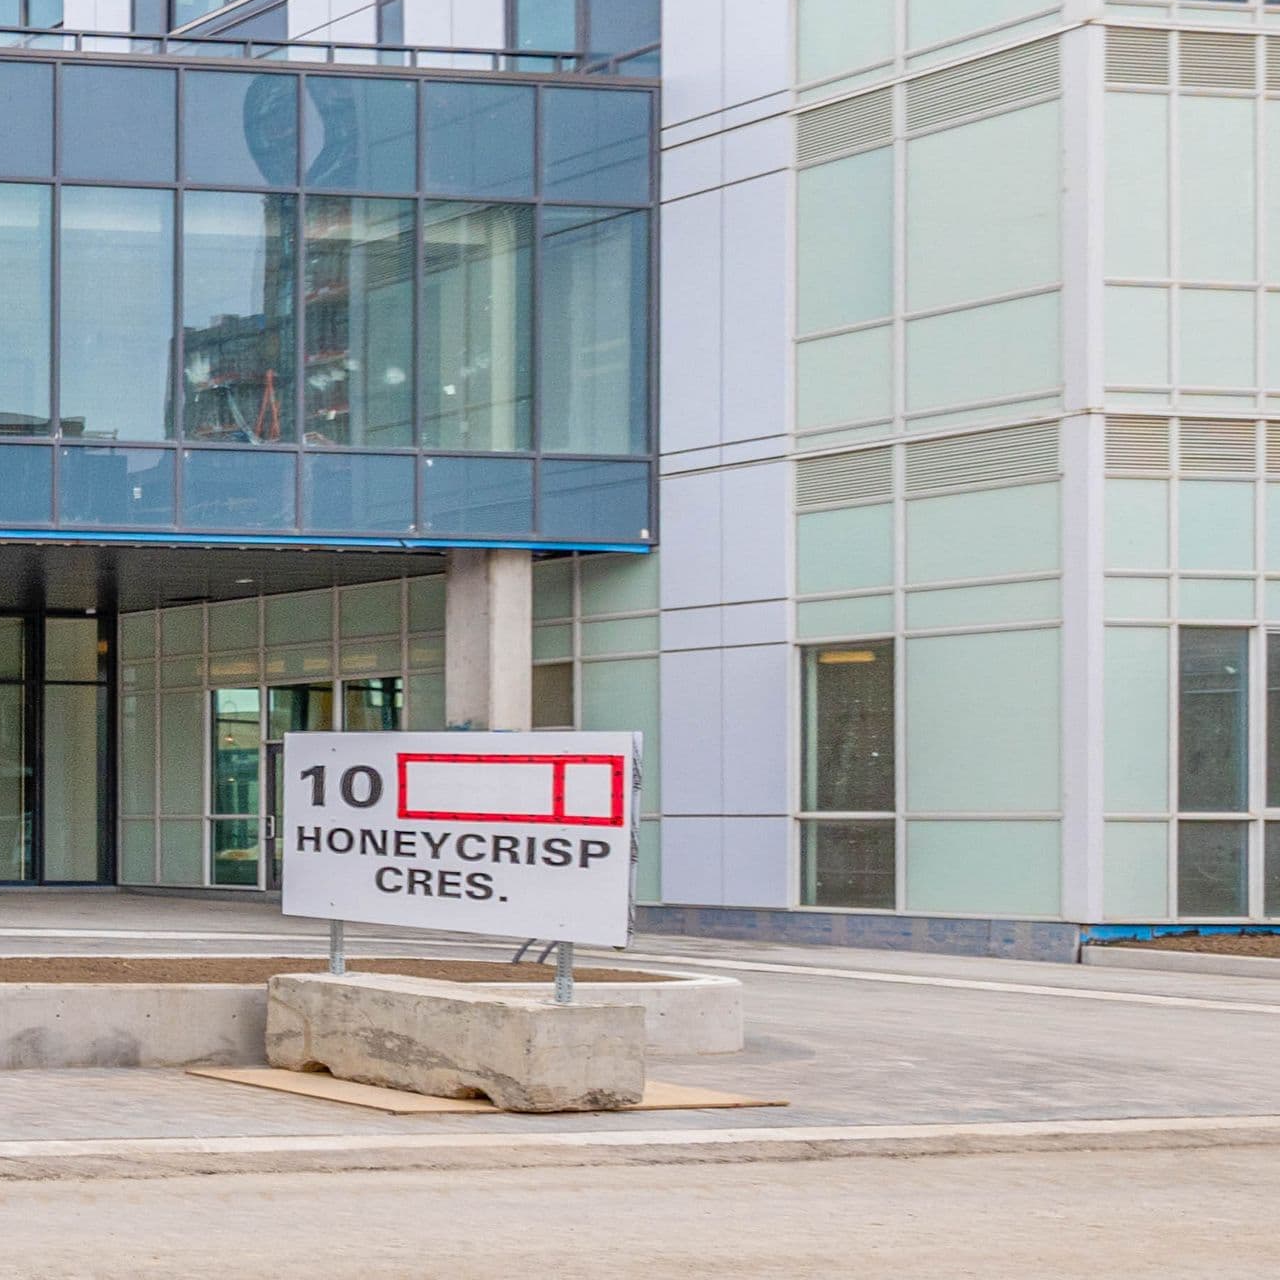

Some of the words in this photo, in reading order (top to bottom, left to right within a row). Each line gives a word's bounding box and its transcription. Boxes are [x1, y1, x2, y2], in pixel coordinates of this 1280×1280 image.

[299, 764, 384, 809] 10
[296, 825, 611, 869] HONEYCRISP
[374, 866, 508, 903] CRES.
